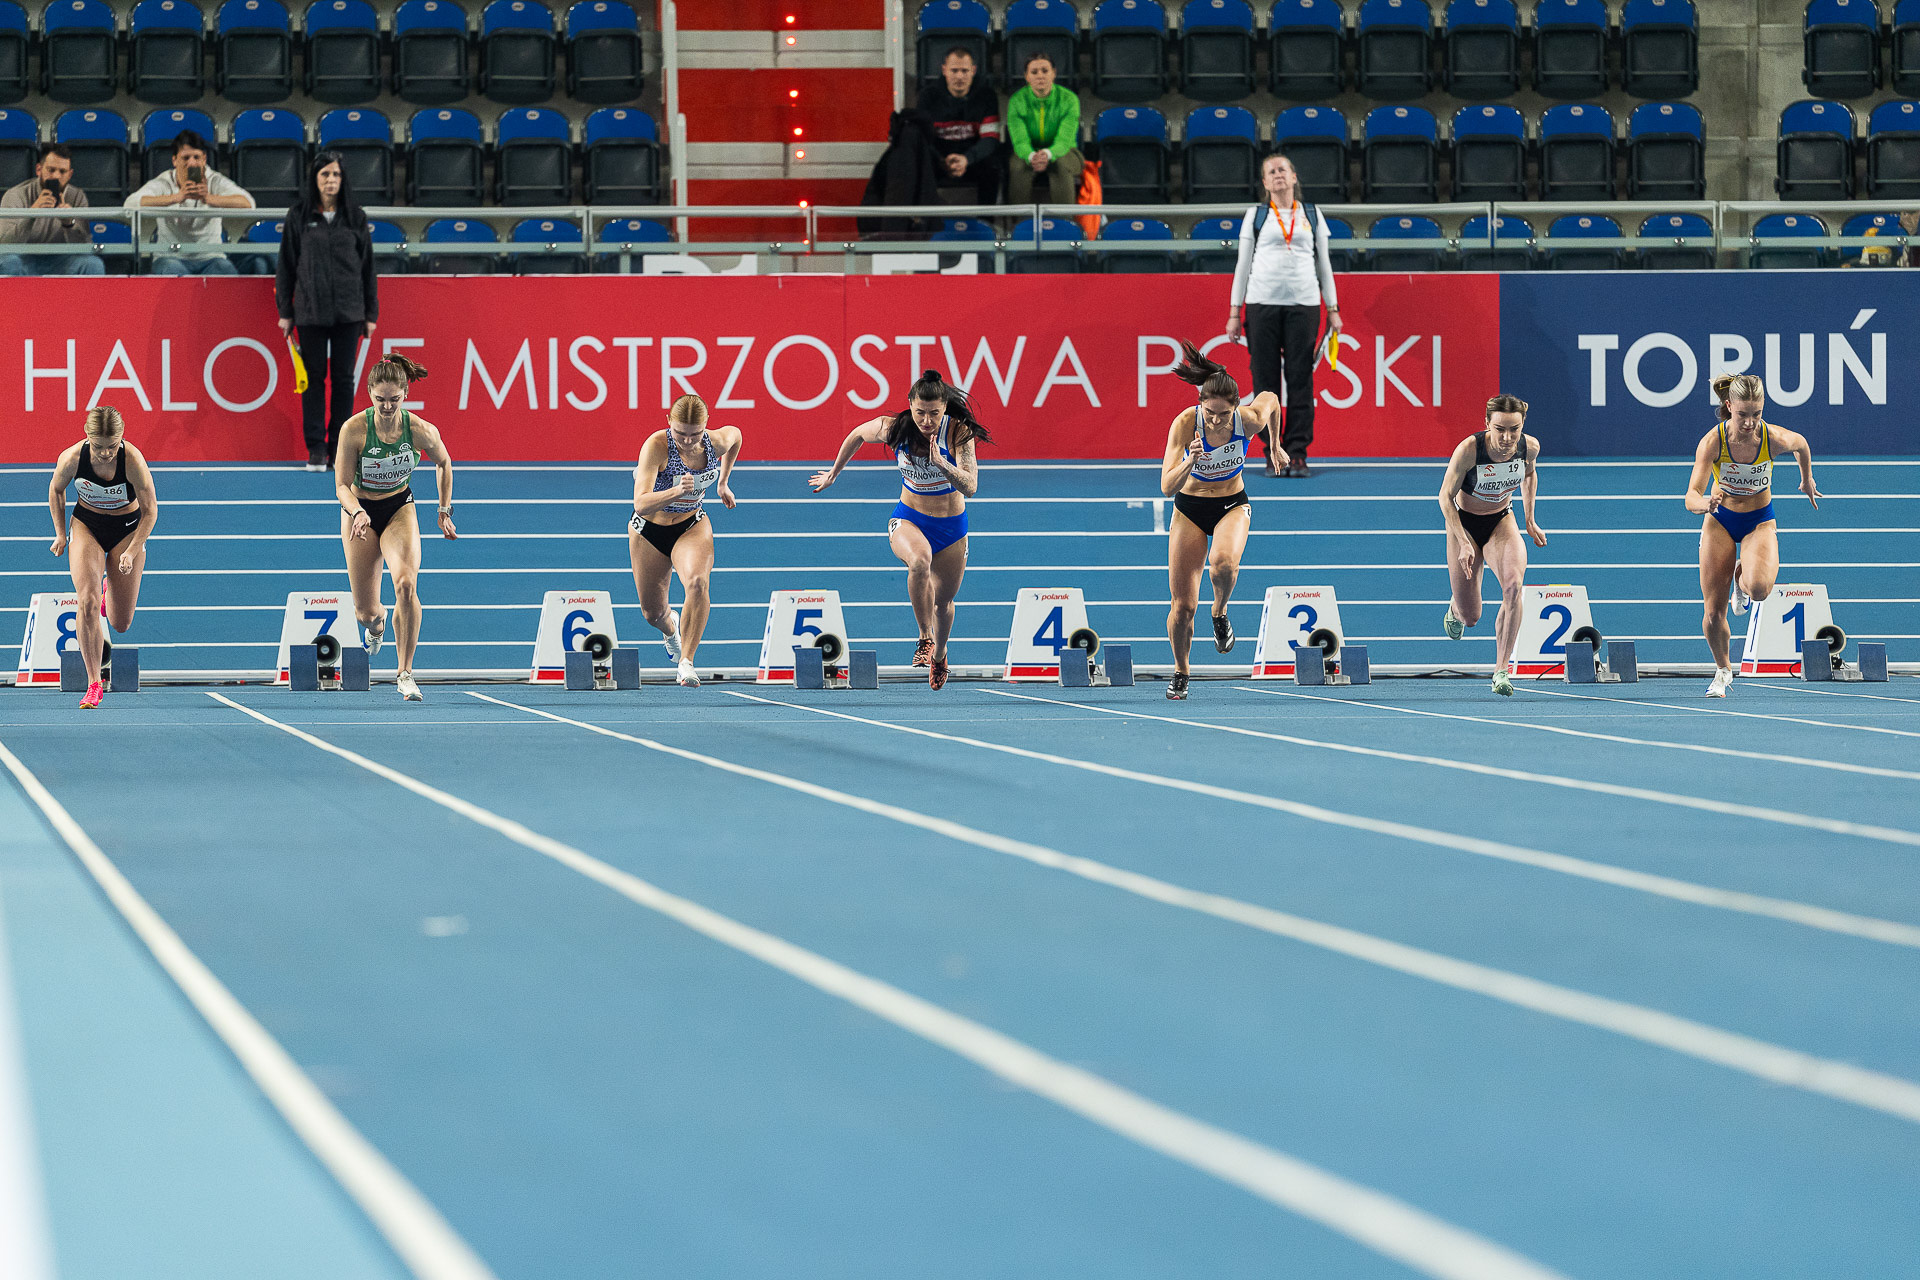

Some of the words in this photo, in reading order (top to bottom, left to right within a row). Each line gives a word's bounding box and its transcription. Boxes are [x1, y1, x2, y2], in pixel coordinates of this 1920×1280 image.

[1578, 308, 1887, 409] TORUŃ
[24, 337, 424, 412] HALO
[458, 334, 1101, 411] MISTRZOSTWA
[1137, 334, 1442, 409] PSKI
[368, 447, 381, 455] 4F
[1223, 444, 1236, 453] 89
[391, 455, 410, 466] 174
[1194, 456, 1243, 471] ROMASZKO
[900, 467, 945, 480] STEFANOWIC
[1508, 463, 1519, 473] 19
[1751, 463, 1768, 474] 387
[699, 472, 715, 483] 326
[1722, 476, 1769, 486] ADAMCIO
[104, 487, 122, 495] 186
[1041, 593, 1069, 601] polanik
[1293, 591, 1321, 599] polanik
[1545, 591, 1573, 599] polanik
[1785, 589, 1814, 597] polanik
[310, 597, 339, 605] polanik
[797, 596, 826, 604] polanik
[304, 610, 338, 637] 7
[1287, 604, 1318, 653] 3
[1539, 604, 1573, 654] 2
[1782, 602, 1805, 653] 1
[56, 611, 80, 658] 8
[562, 610, 594, 652] 6
[792, 609, 822, 653] 5
[1033, 606, 1068, 656] 4
